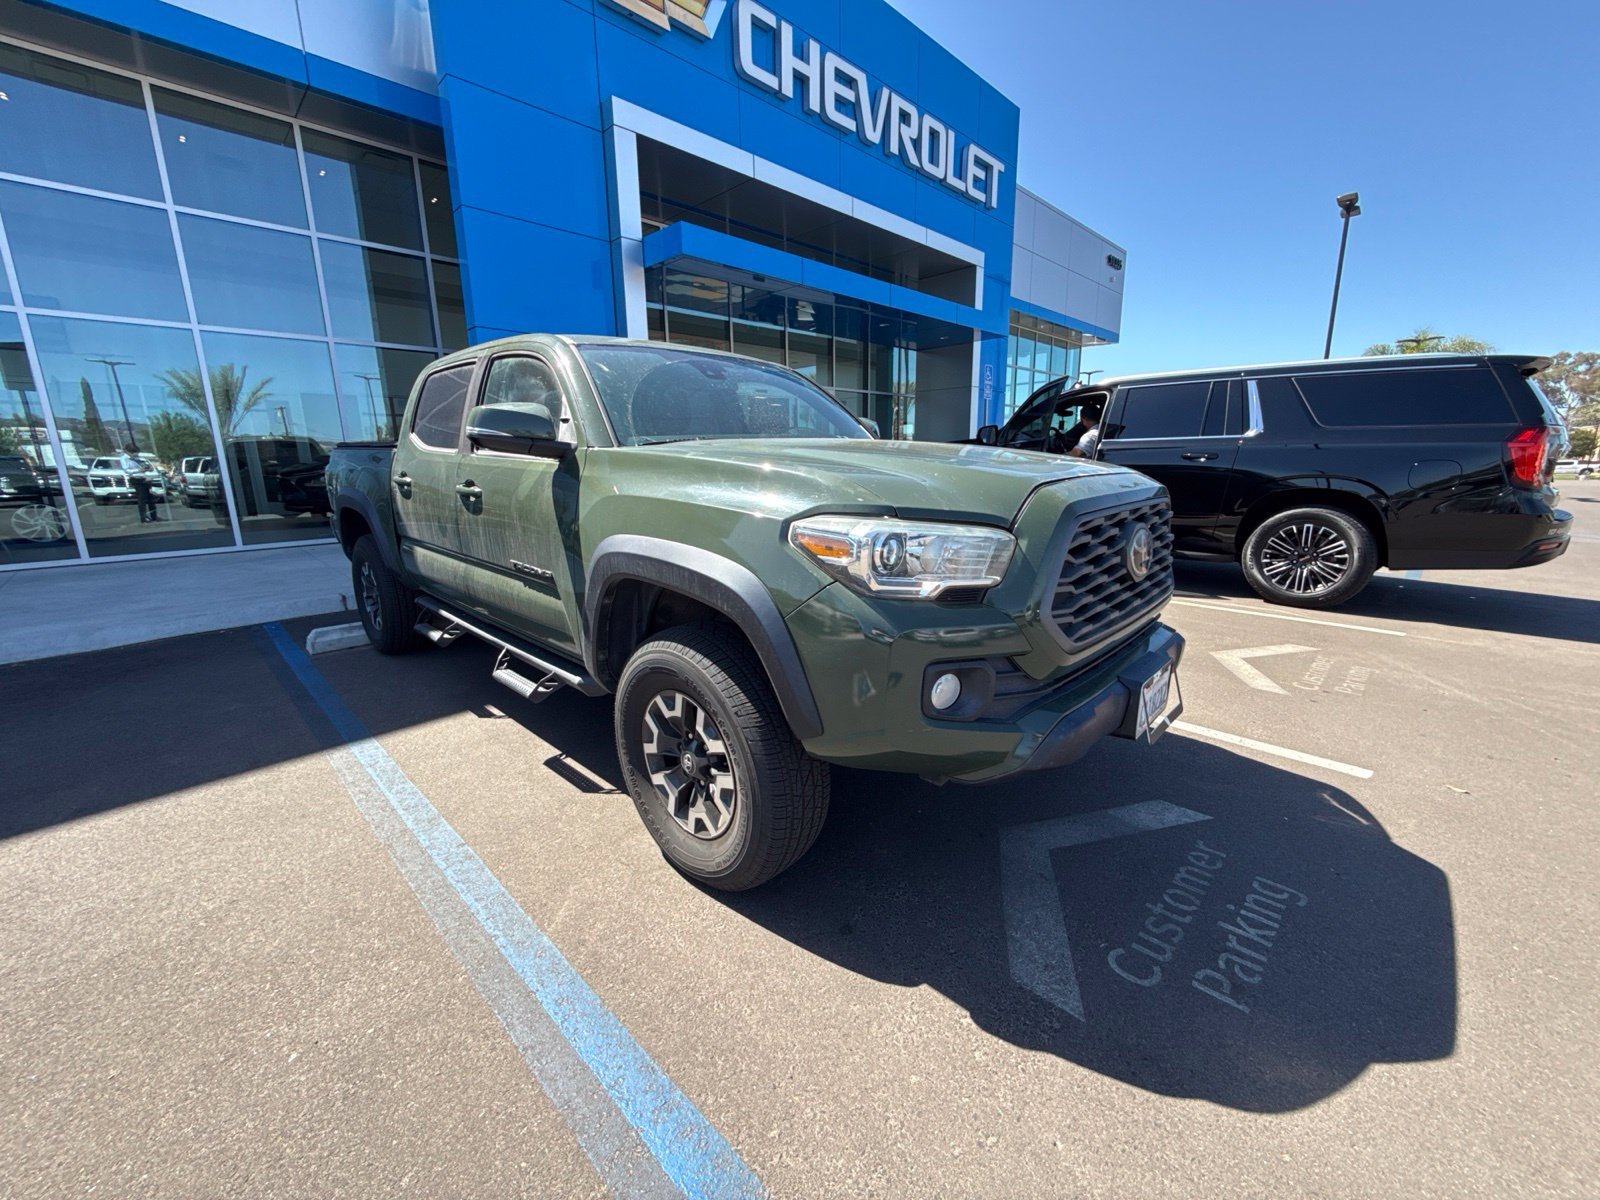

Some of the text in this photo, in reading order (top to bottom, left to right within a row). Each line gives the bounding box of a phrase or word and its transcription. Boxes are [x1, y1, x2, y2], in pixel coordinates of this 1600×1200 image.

[735, 0, 1004, 209] CHEVROLET
[1107, 840, 1227, 988] Customer
[1191, 876, 1308, 1014] Parking
